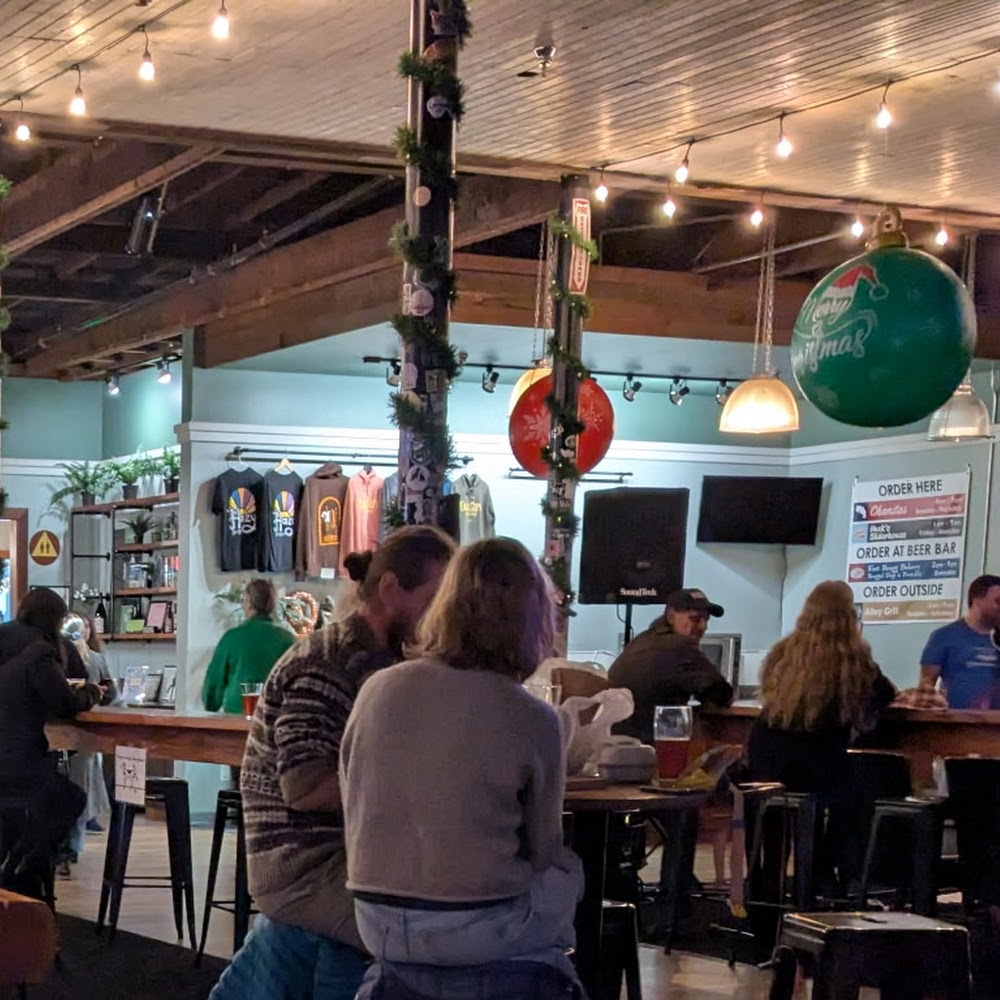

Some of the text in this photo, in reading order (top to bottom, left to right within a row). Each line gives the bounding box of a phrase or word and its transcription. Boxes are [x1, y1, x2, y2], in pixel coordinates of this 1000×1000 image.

[878, 479, 943, 497] ORDER HERE
[856, 542, 956, 559] ORDER AT BEER BAR
[863, 584, 944, 598] ORDER OUTSIDE
